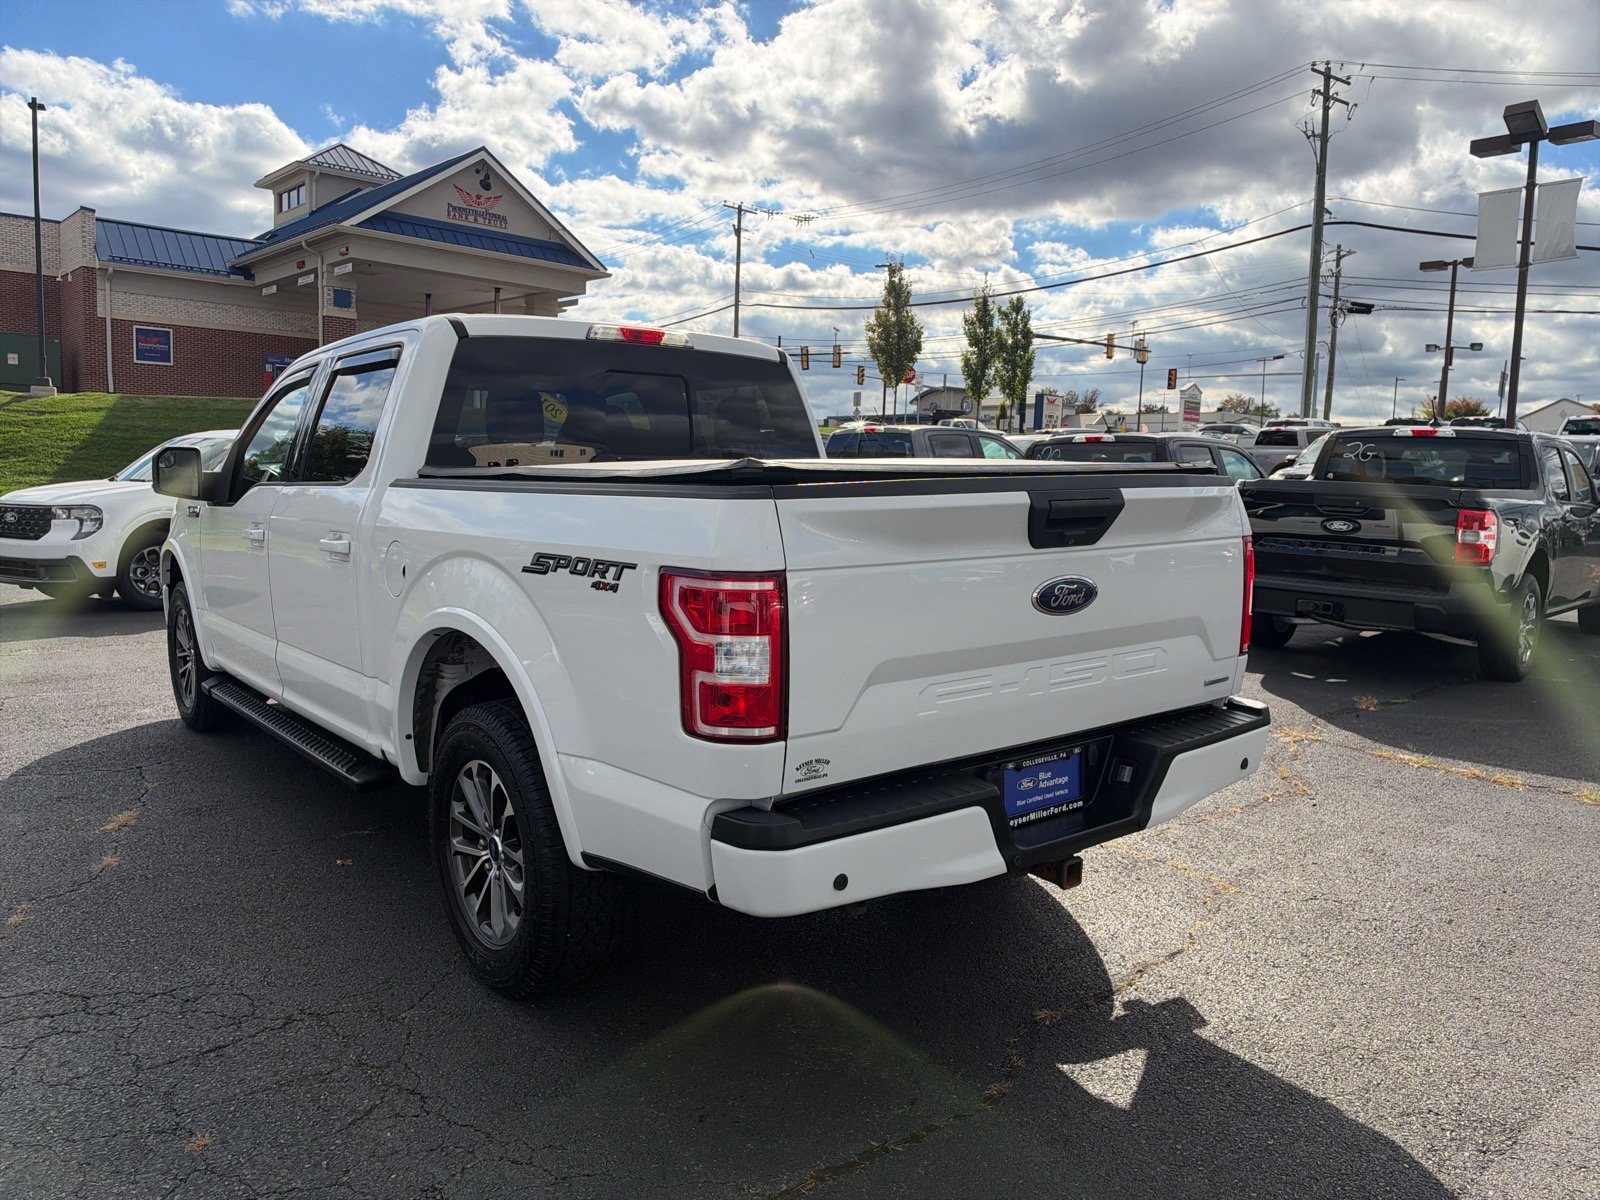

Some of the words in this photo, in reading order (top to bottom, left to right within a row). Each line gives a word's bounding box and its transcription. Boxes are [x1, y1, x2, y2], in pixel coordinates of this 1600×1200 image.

[521, 552, 638, 581] SPORT
[1050, 583, 1086, 608] Ford
[1038, 771, 1052, 779] Blue
[1038, 776, 1069, 789] Advantage
[1026, 794, 1043, 804] Certified
[1055, 788, 1069, 796] Vehicle
[1009, 800, 1084, 827] eyserMillerFord.com
